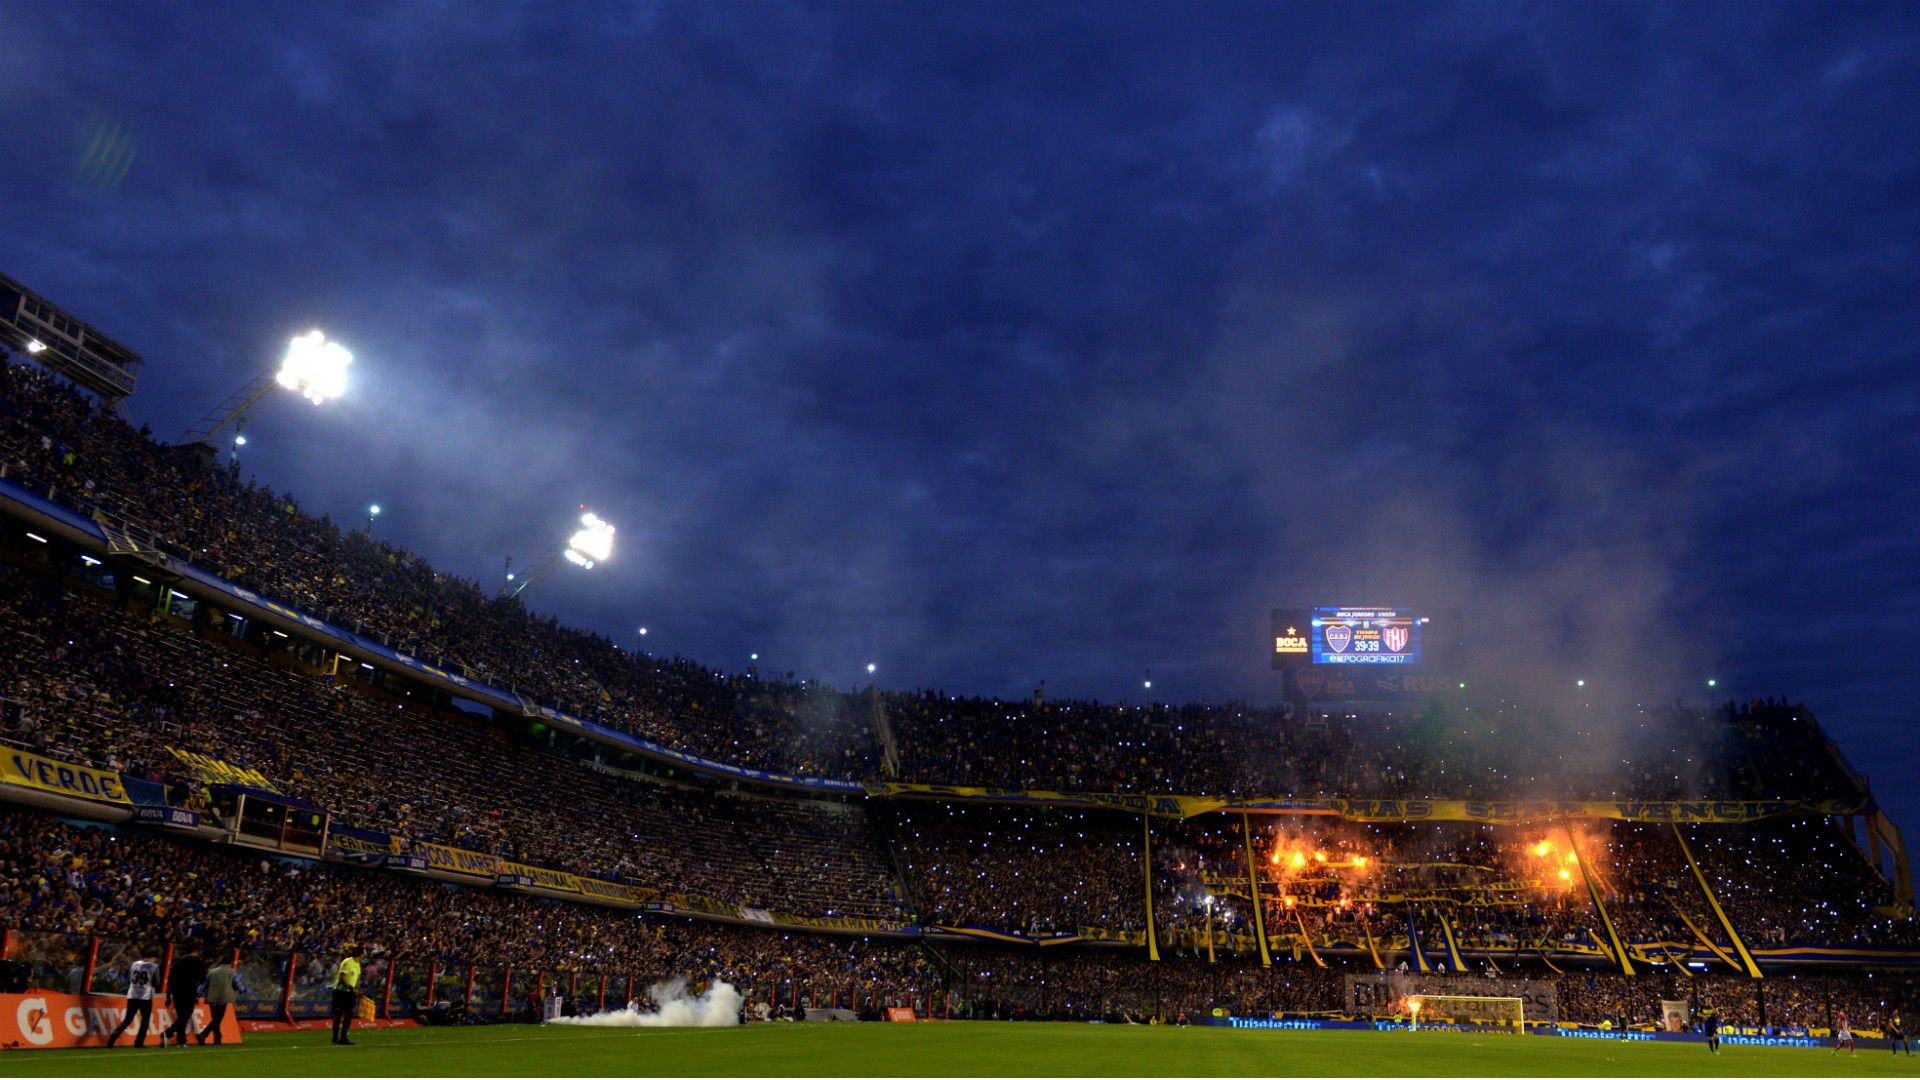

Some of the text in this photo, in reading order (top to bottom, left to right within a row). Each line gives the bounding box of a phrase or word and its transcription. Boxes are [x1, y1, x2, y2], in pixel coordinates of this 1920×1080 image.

[1276, 637, 1308, 648] BOCA
[1403, 675, 1453, 692] RUS
[12, 755, 123, 800] VERDE
[131, 970, 148, 985] 39
